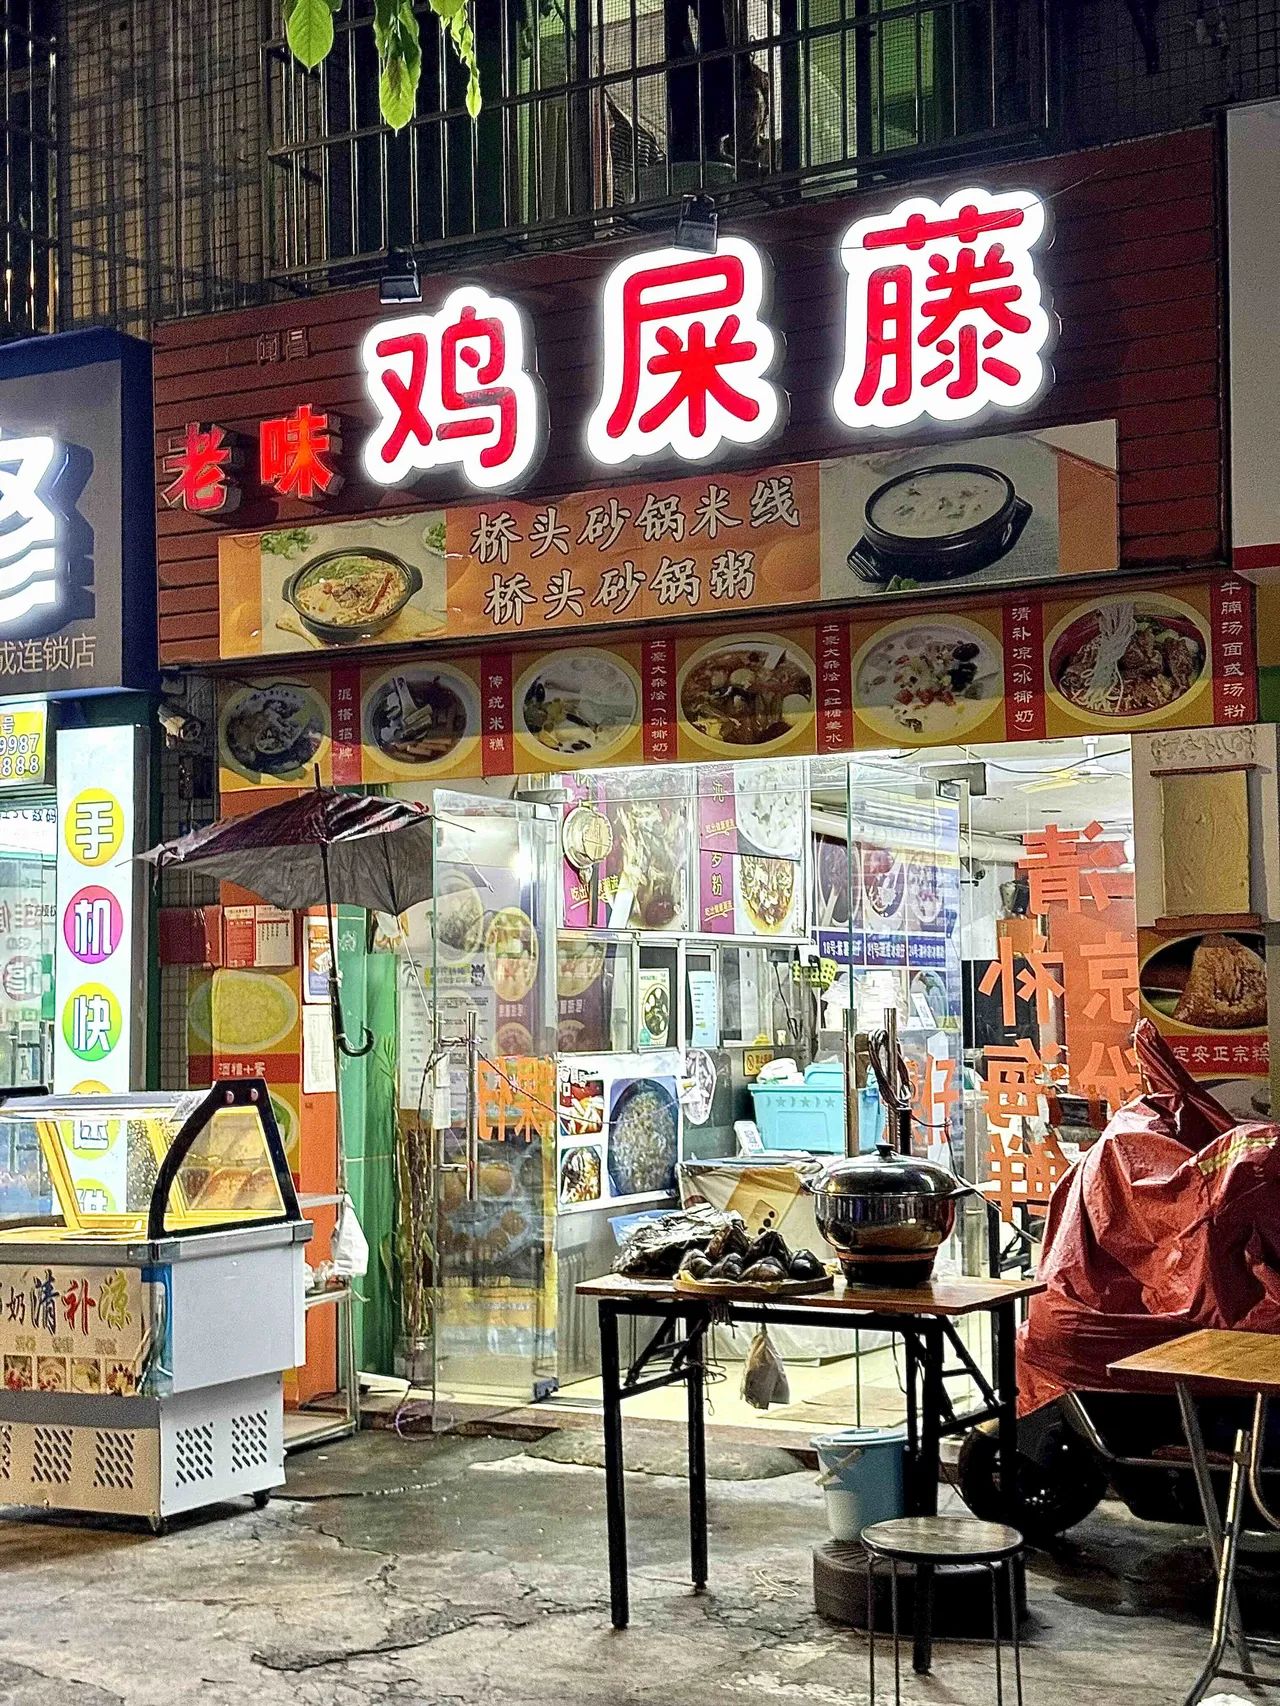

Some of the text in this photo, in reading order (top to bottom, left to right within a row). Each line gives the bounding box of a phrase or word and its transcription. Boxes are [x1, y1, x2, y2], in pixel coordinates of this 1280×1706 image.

[374, 204, 1031, 468] 鸡屎藤
[161, 403, 334, 513] 老味
[469, 477, 800, 564] 桥头砂锅米线
[483, 550, 757, 626] 桥头砂锅粥
[1220, 581, 1247, 718] 牛腩汤面或汤粉
[337, 688, 354, 760] 混搭招牌
[0, 1268, 133, 1337] 奶清补凉
